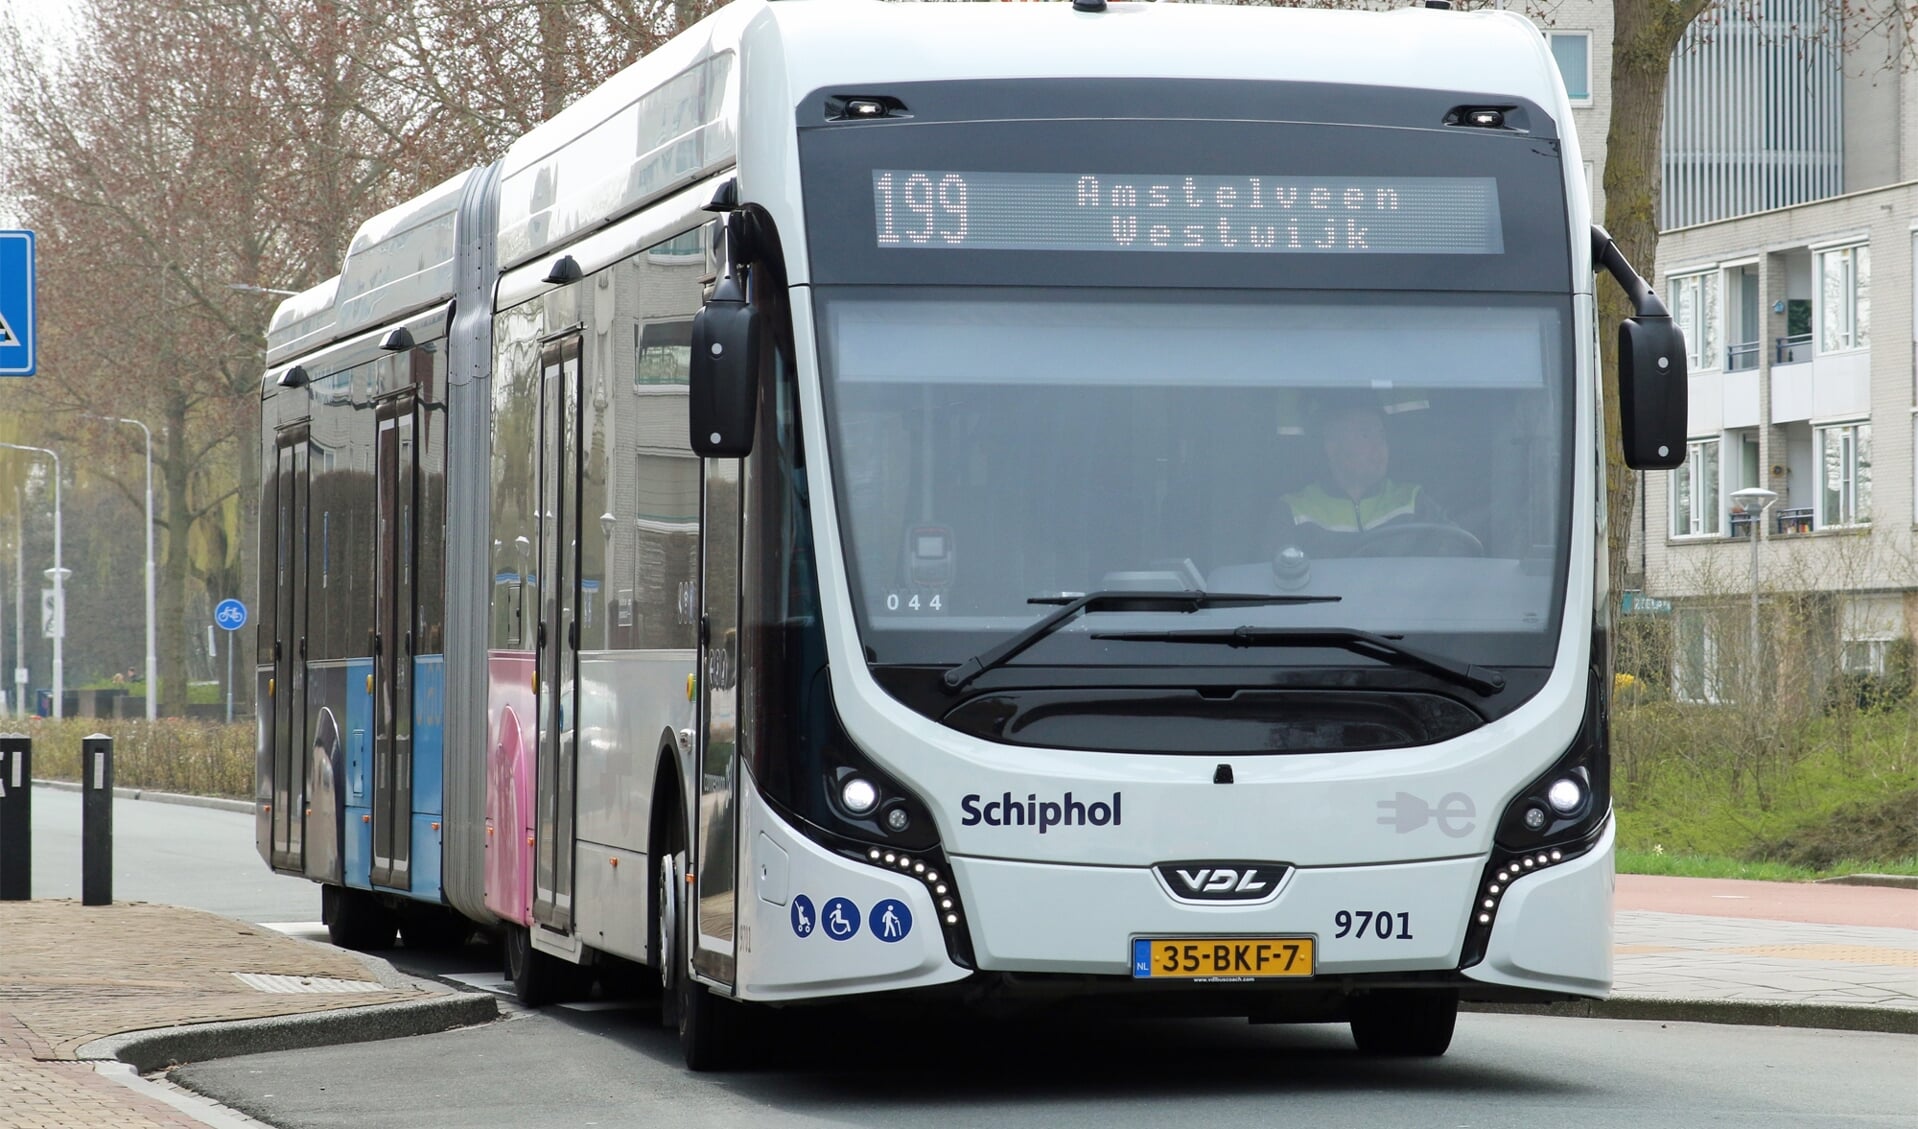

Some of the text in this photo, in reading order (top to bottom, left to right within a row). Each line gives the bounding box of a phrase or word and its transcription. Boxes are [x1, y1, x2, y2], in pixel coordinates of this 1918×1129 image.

[877, 172, 968, 244] 199
[1078, 175, 1399, 211] Amstelveen
[1112, 214, 1369, 250] Westwijk
[961, 791, 1122, 834] Schiphol
[1175, 868, 1267, 893] VDL
[1334, 909, 1414, 940] 9701
[1136, 945, 1300, 971] NL 35-BKF-7
